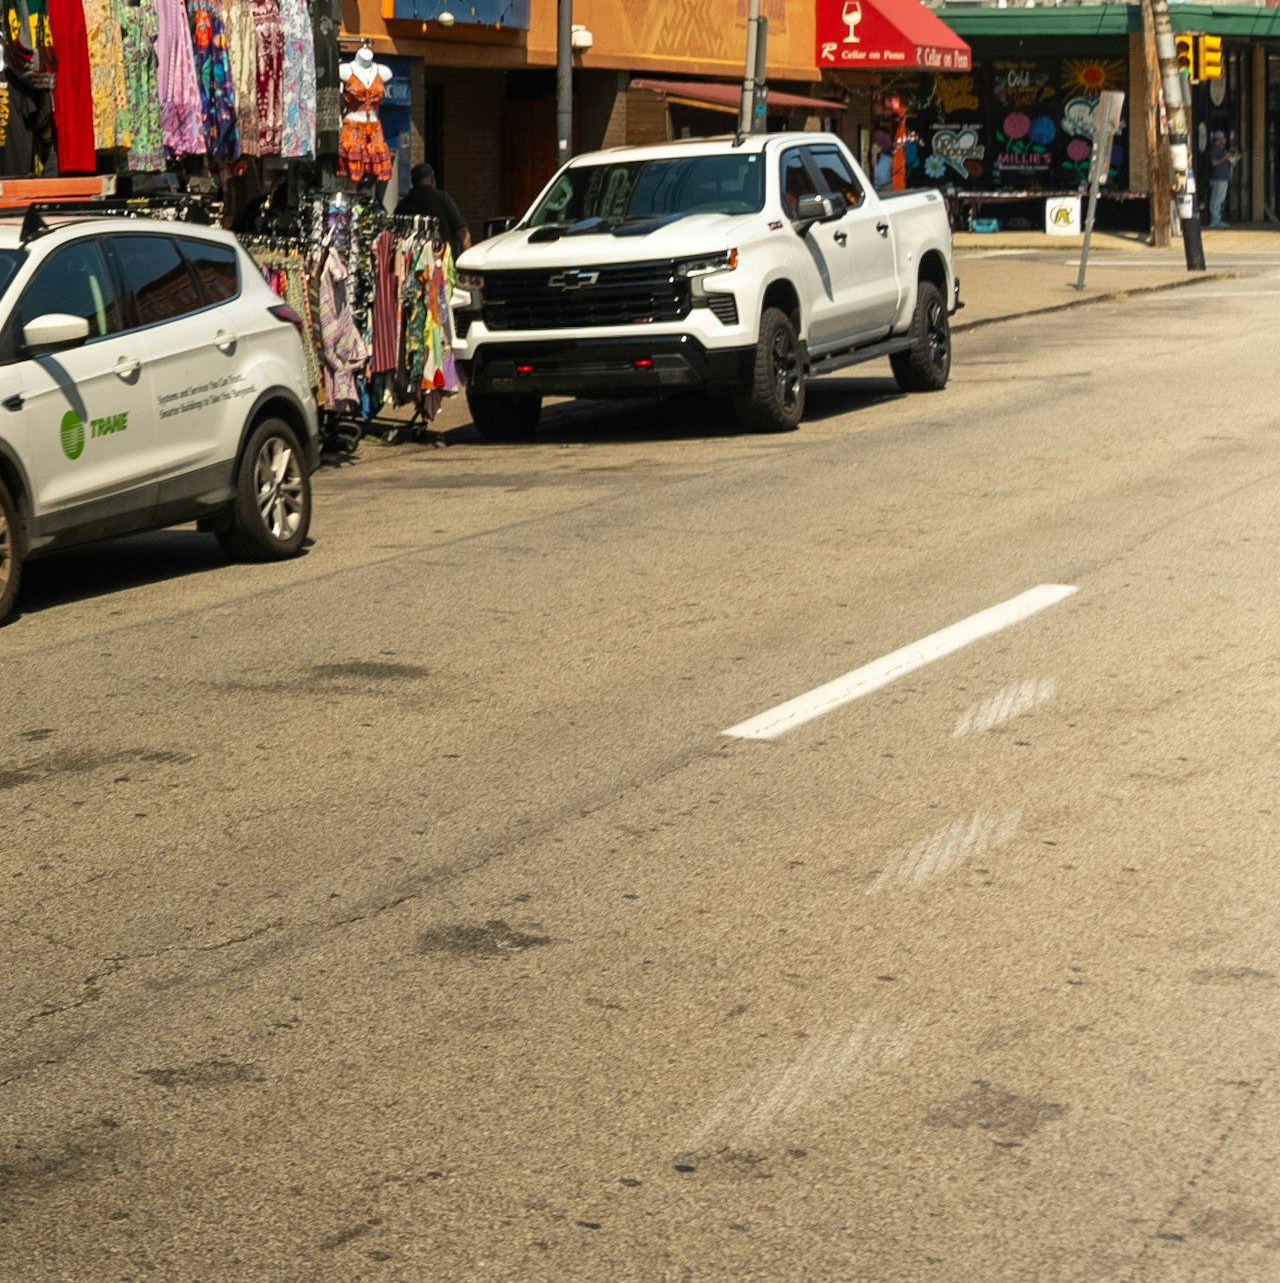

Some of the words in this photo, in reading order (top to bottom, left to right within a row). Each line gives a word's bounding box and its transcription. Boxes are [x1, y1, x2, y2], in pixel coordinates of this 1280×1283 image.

[841, 49, 866, 61] Cellar
[869, 51, 880, 61] on
[884, 49, 906, 61] Penn
[924, 47, 942, 66] Cellar
[943, 54, 952, 67] on
[953, 50, 969, 69] Penn
[997, 152, 1053, 165] MILLIE'S
[90, 412, 130, 439] TRANE
